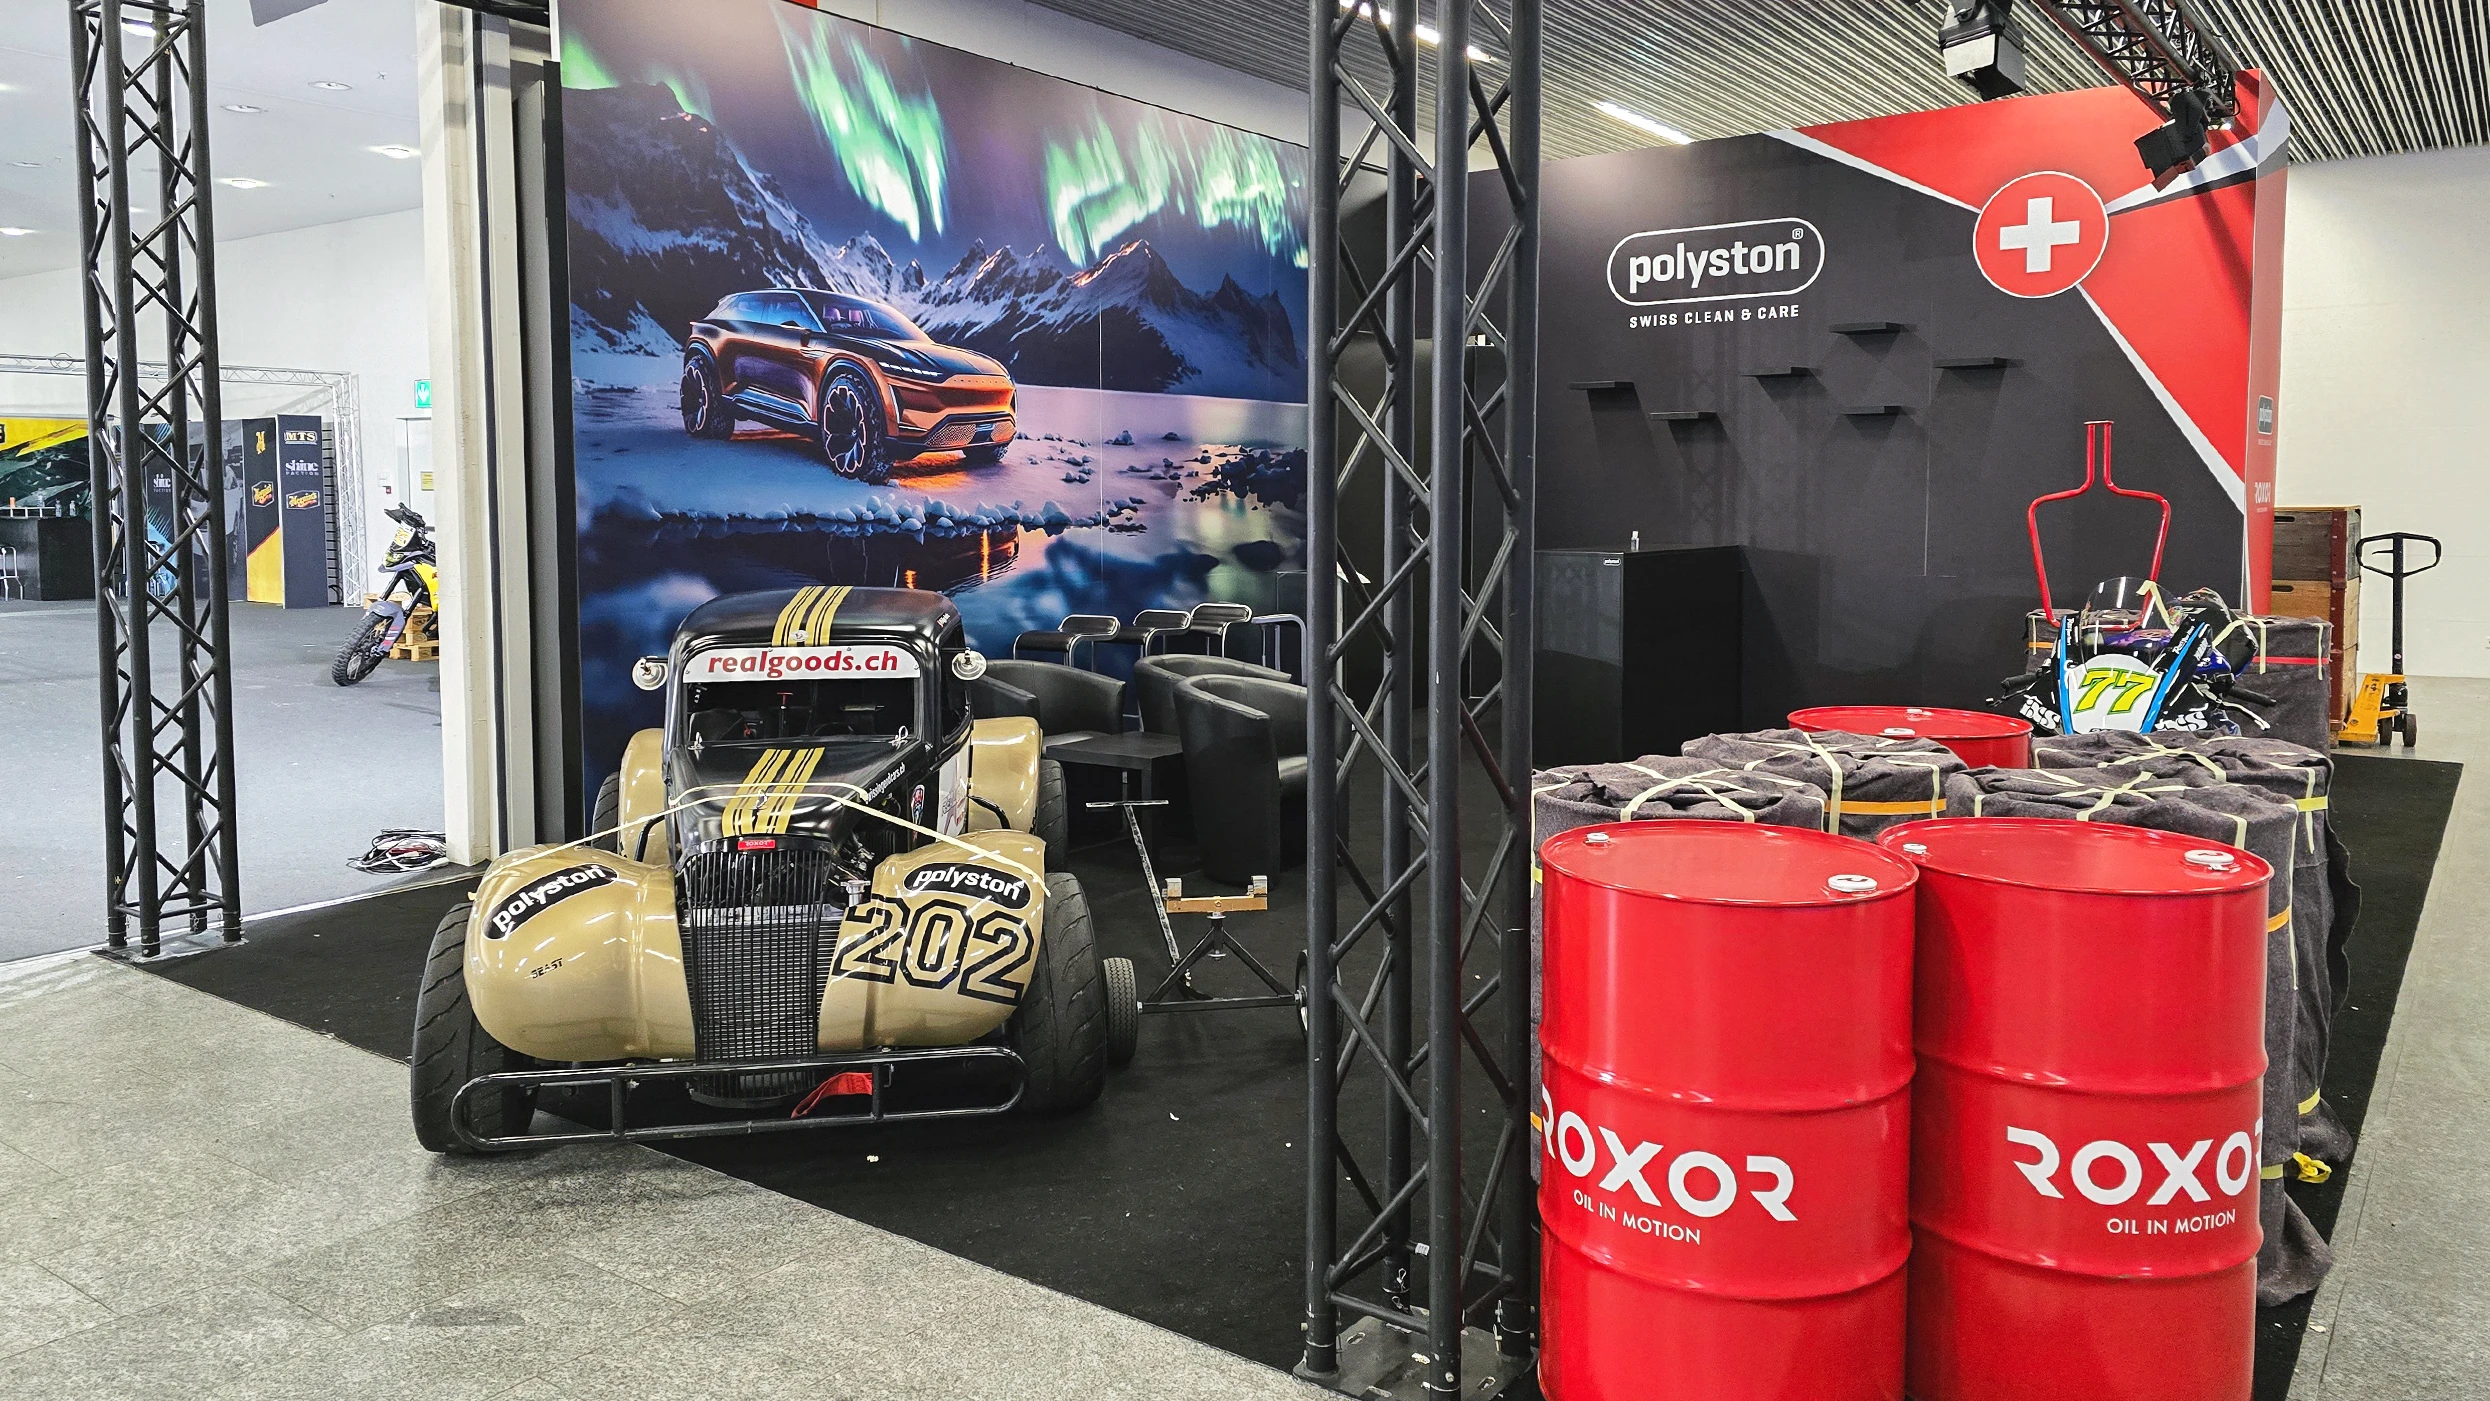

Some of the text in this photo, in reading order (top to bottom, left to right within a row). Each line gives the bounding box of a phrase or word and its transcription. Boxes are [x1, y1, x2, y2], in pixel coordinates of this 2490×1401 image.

[1629, 304, 1800, 329] SWISS CLEAN & CARE
[285, 432, 316, 442] MTS
[708, 650, 898, 678] realgoods.ch
[2073, 667, 2158, 715] 77
[492, 865, 607, 933] polyston
[913, 866, 1024, 901] polyston
[831, 892, 1034, 1007] 202
[1573, 1189, 1700, 1245] OIL IN MOTION
[2106, 1208, 2236, 1235] OIL IN MOTION
